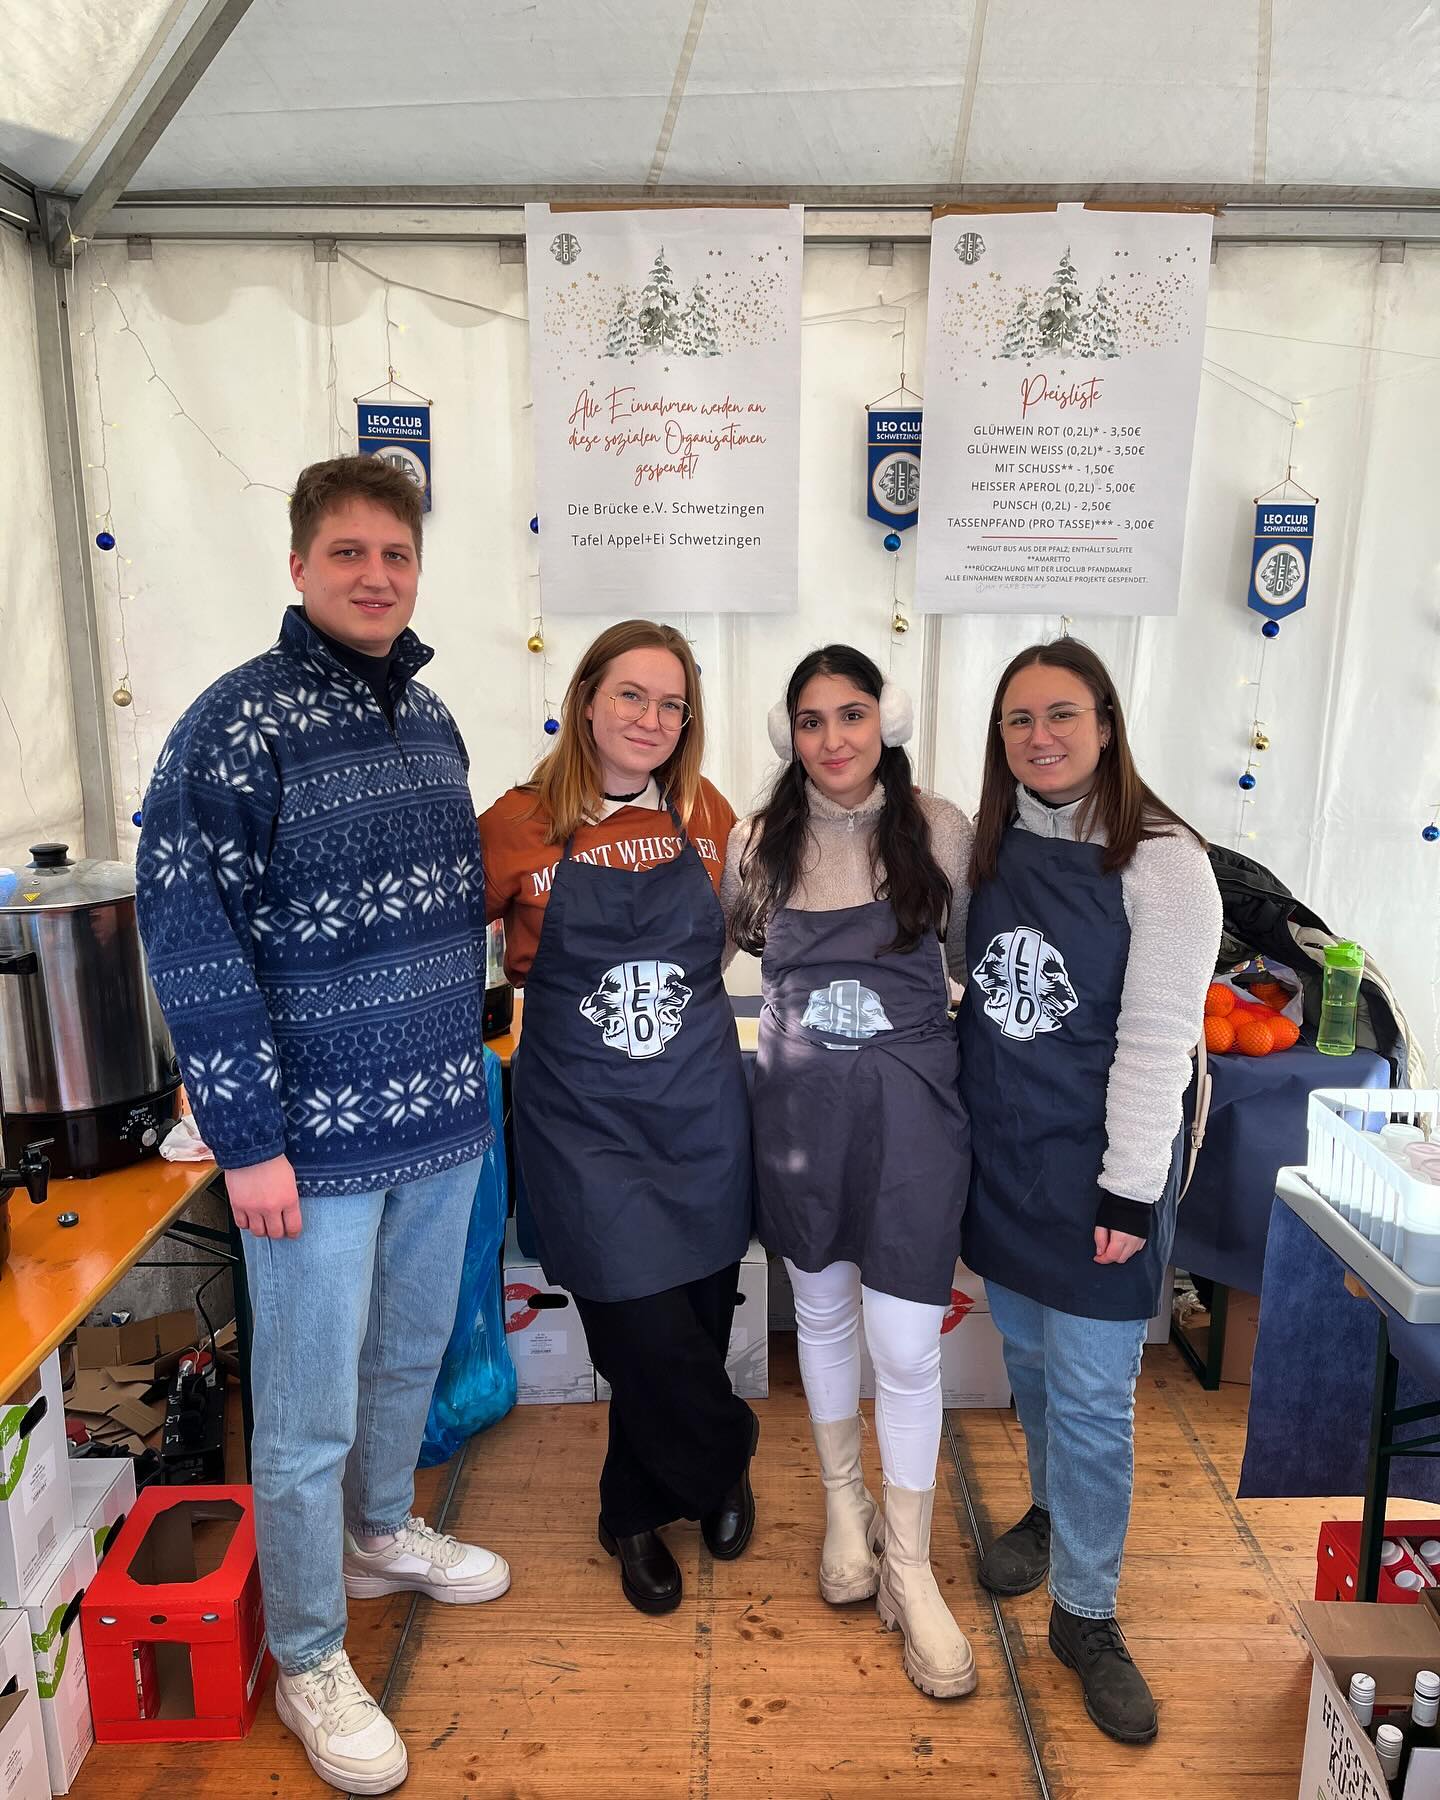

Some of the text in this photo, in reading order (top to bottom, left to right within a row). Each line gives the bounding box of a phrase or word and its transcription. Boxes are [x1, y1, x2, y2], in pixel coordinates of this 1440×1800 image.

[966, 234, 974, 261] LEO
[1021, 374, 1104, 419] Preisliste
[569, 386, 766, 430] Alle Einnahmen werden an
[367, 415, 422, 428] LEO CLUB
[876, 421, 922, 432] LEO CLU
[368, 427, 422, 436] SCHWETZINGEN
[974, 424, 1033, 435] GLÜHWEIN
[1038, 426, 1060, 436] ROT
[1111, 427, 1141, 437] 3,50€
[568, 420, 766, 455] diese sozialen Organisationen
[968, 443, 1026, 454] GLÜHWEIN
[1031, 445, 1063, 455] WEISS
[1115, 446, 1145, 456] 3,50€
[634, 453, 699, 486] gespendet!
[995, 464, 1015, 472] MIT
[1085, 465, 1114, 475] 1,50€
[972, 482, 1015, 491] HEISSER
[1019, 482, 1061, 492] APEROL
[1065, 483, 1094, 494] (0,2L)
[1106, 483, 1135, 493] 5,00€
[568, 502, 764, 518] Die Brücke e.V. Schwetzingen
[993, 501, 1037, 510] PUNSCH
[1042, 501, 1070, 512] (0,2L)
[1082, 502, 1111, 512] 2,50€
[948, 518, 1025, 527] TASSENPFAND
[1029, 519, 1054, 529] (PRO
[1125, 520, 1154, 530] 3,00€
[1264, 514, 1308, 525] LEO CLUB
[1263, 525, 1308, 533] SCHWETZINGEN
[572, 533, 760, 549] Tafel Appel+Ei Schwetzingen
[1017, 545, 1032, 553] AUS
[1033, 545, 1047, 553] DER
[1106, 546, 1133, 554] SULFITE
[1040, 565, 1055, 573] DER
[1055, 565, 1086, 573] LEOCLUB
[1087, 566, 1133, 574] PFANDMARKE
[1276, 555, 1285, 592] LEO
[944, 574, 961, 582] ALLE
[962, 574, 1004, 582] EINNAHMEN
[1004, 575, 1034, 583] WERDEN
[1045, 575, 1074, 583] SOZIALE
[1074, 575, 1106, 584] PROJEKTE
[1011, 937, 1036, 1025] LEO
[632, 965, 654, 1042] LEO
